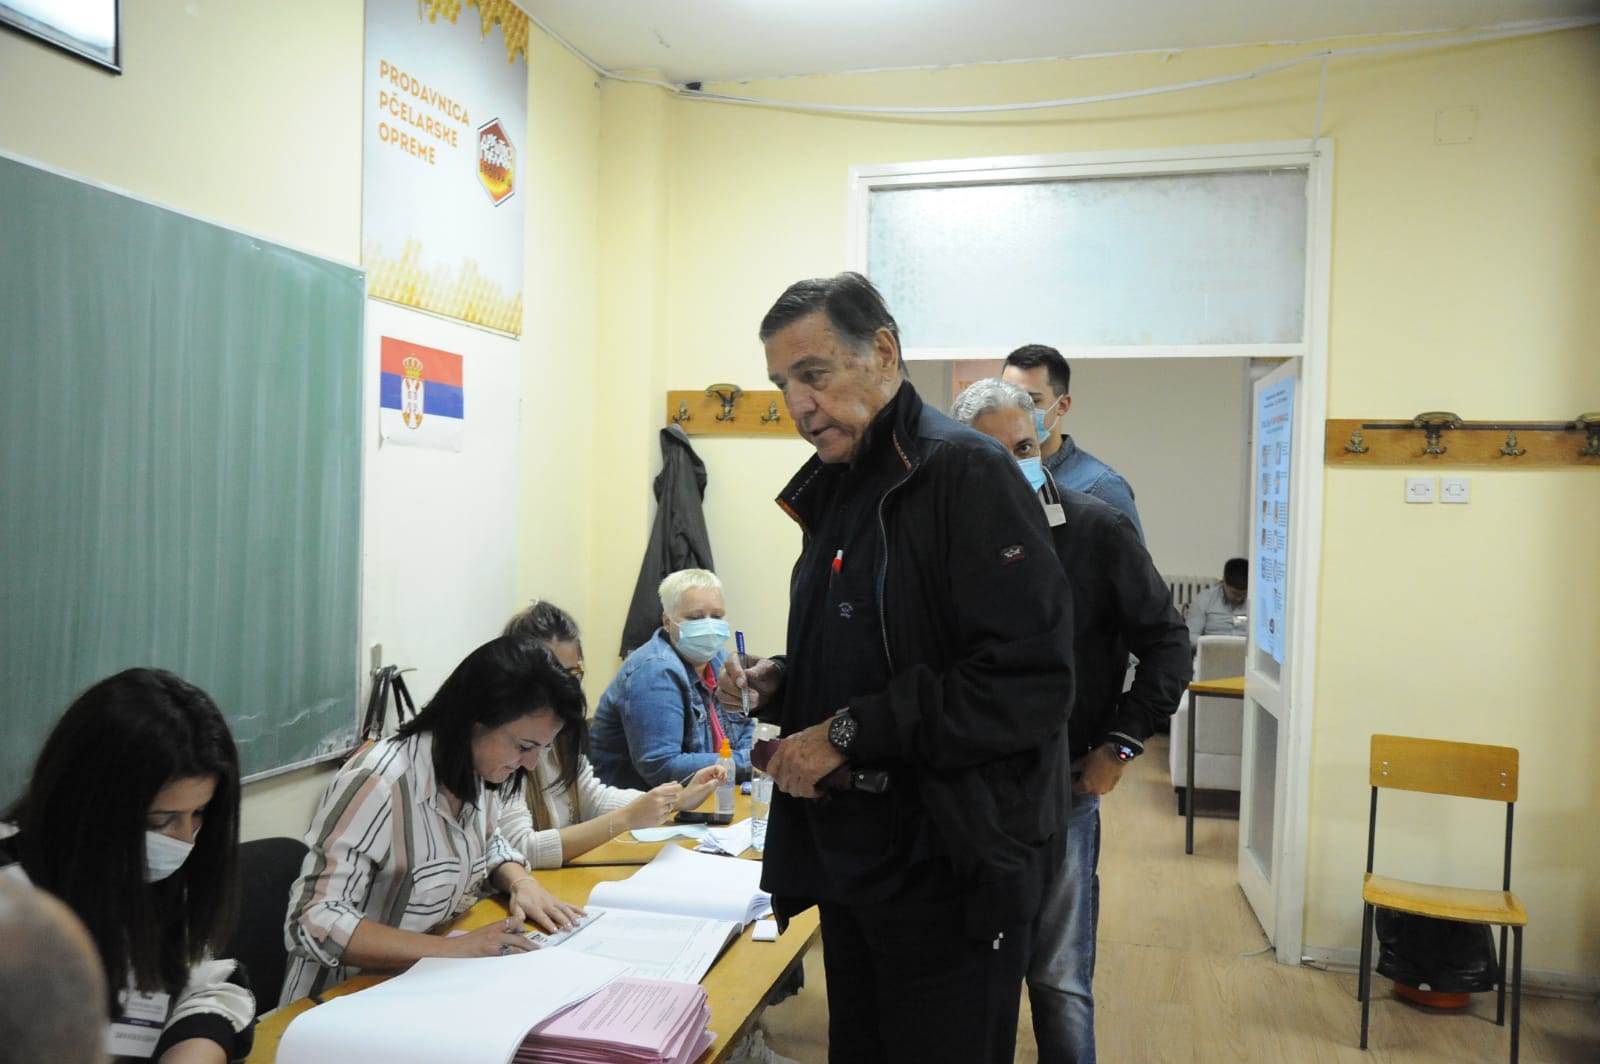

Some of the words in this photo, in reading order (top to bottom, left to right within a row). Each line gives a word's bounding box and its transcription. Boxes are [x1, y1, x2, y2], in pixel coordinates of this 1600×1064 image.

[379, 91, 458, 147] PČELARSKE
[380, 59, 469, 125] PRODAVNICA
[379, 122, 436, 164] OPREME
